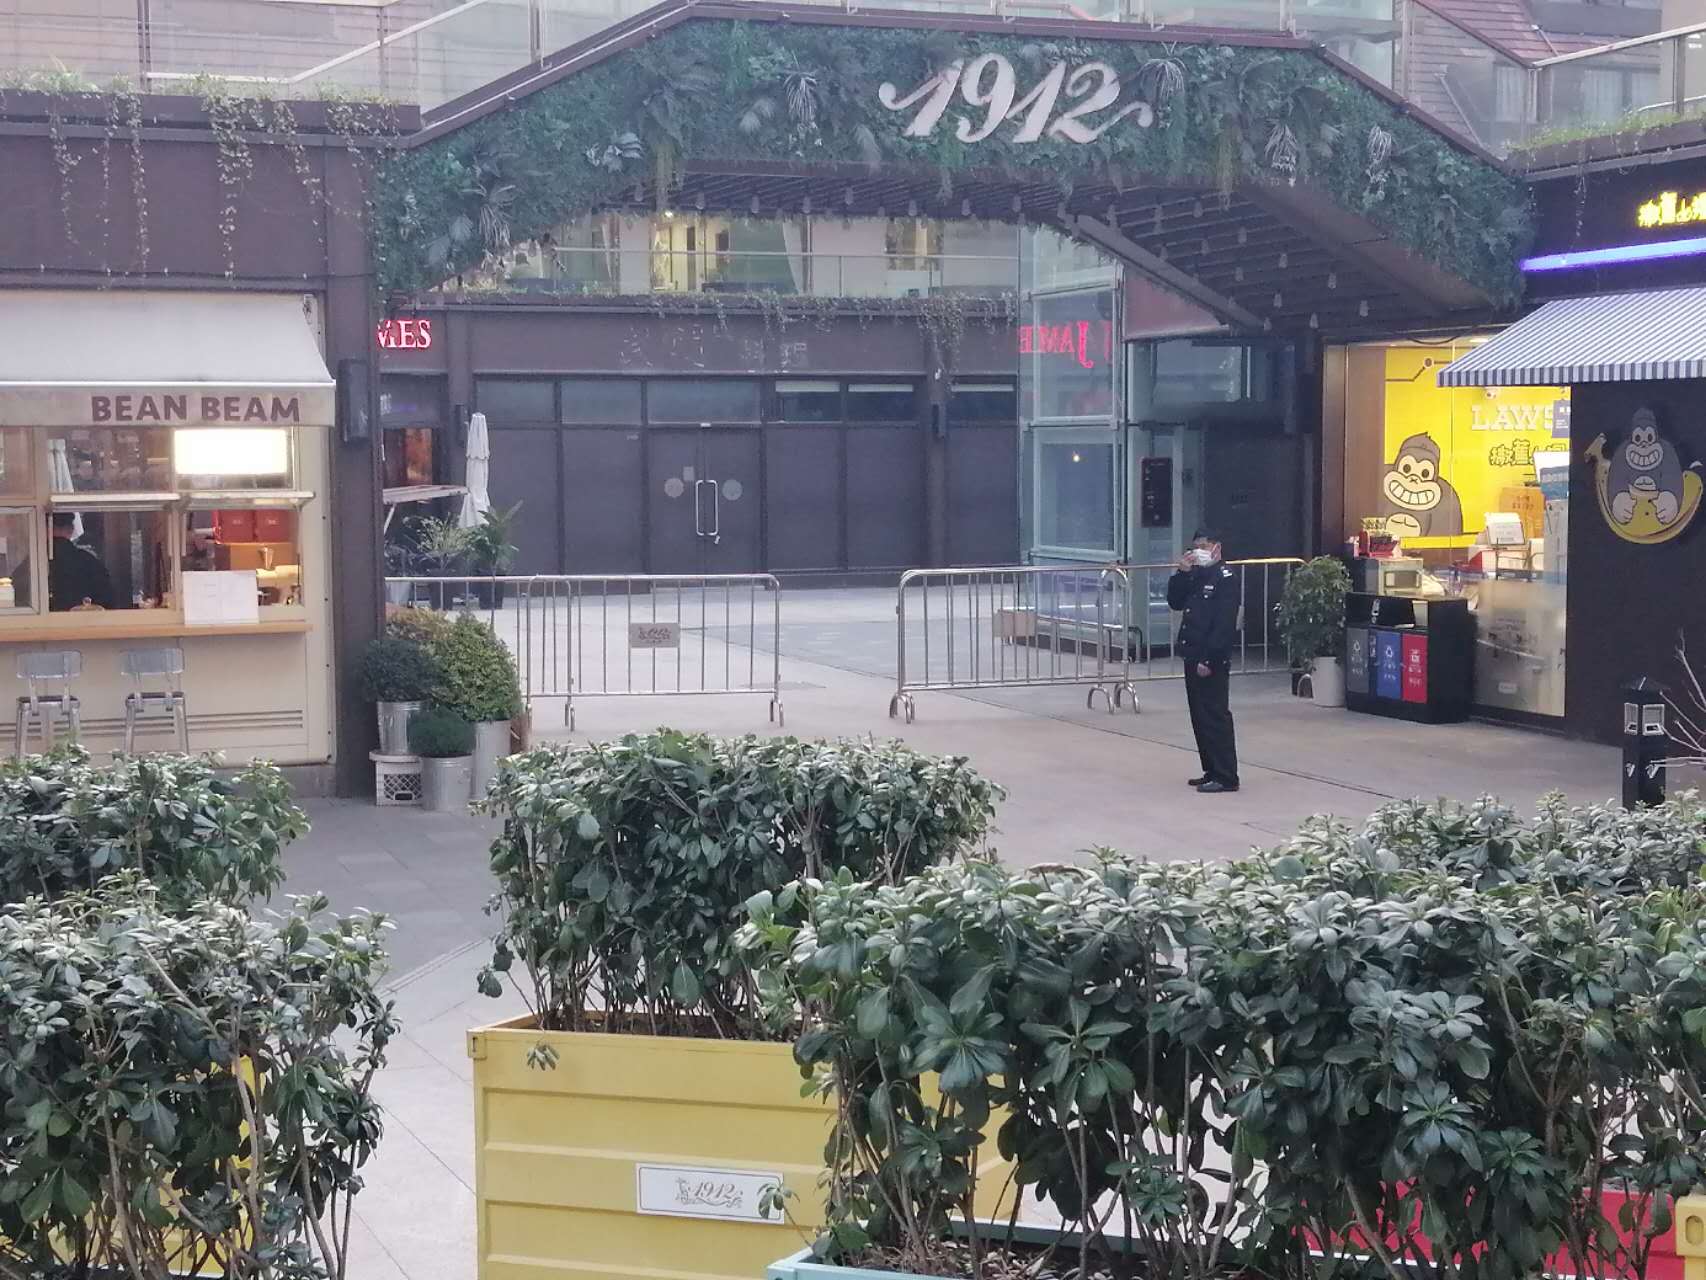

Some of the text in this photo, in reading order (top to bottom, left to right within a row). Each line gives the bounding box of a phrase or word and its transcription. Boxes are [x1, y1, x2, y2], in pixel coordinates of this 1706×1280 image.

[878, 53, 1153, 144] 1912
[91, 394, 300, 422] BEAN BEAM
[687, 1180, 743, 1200] 1912
